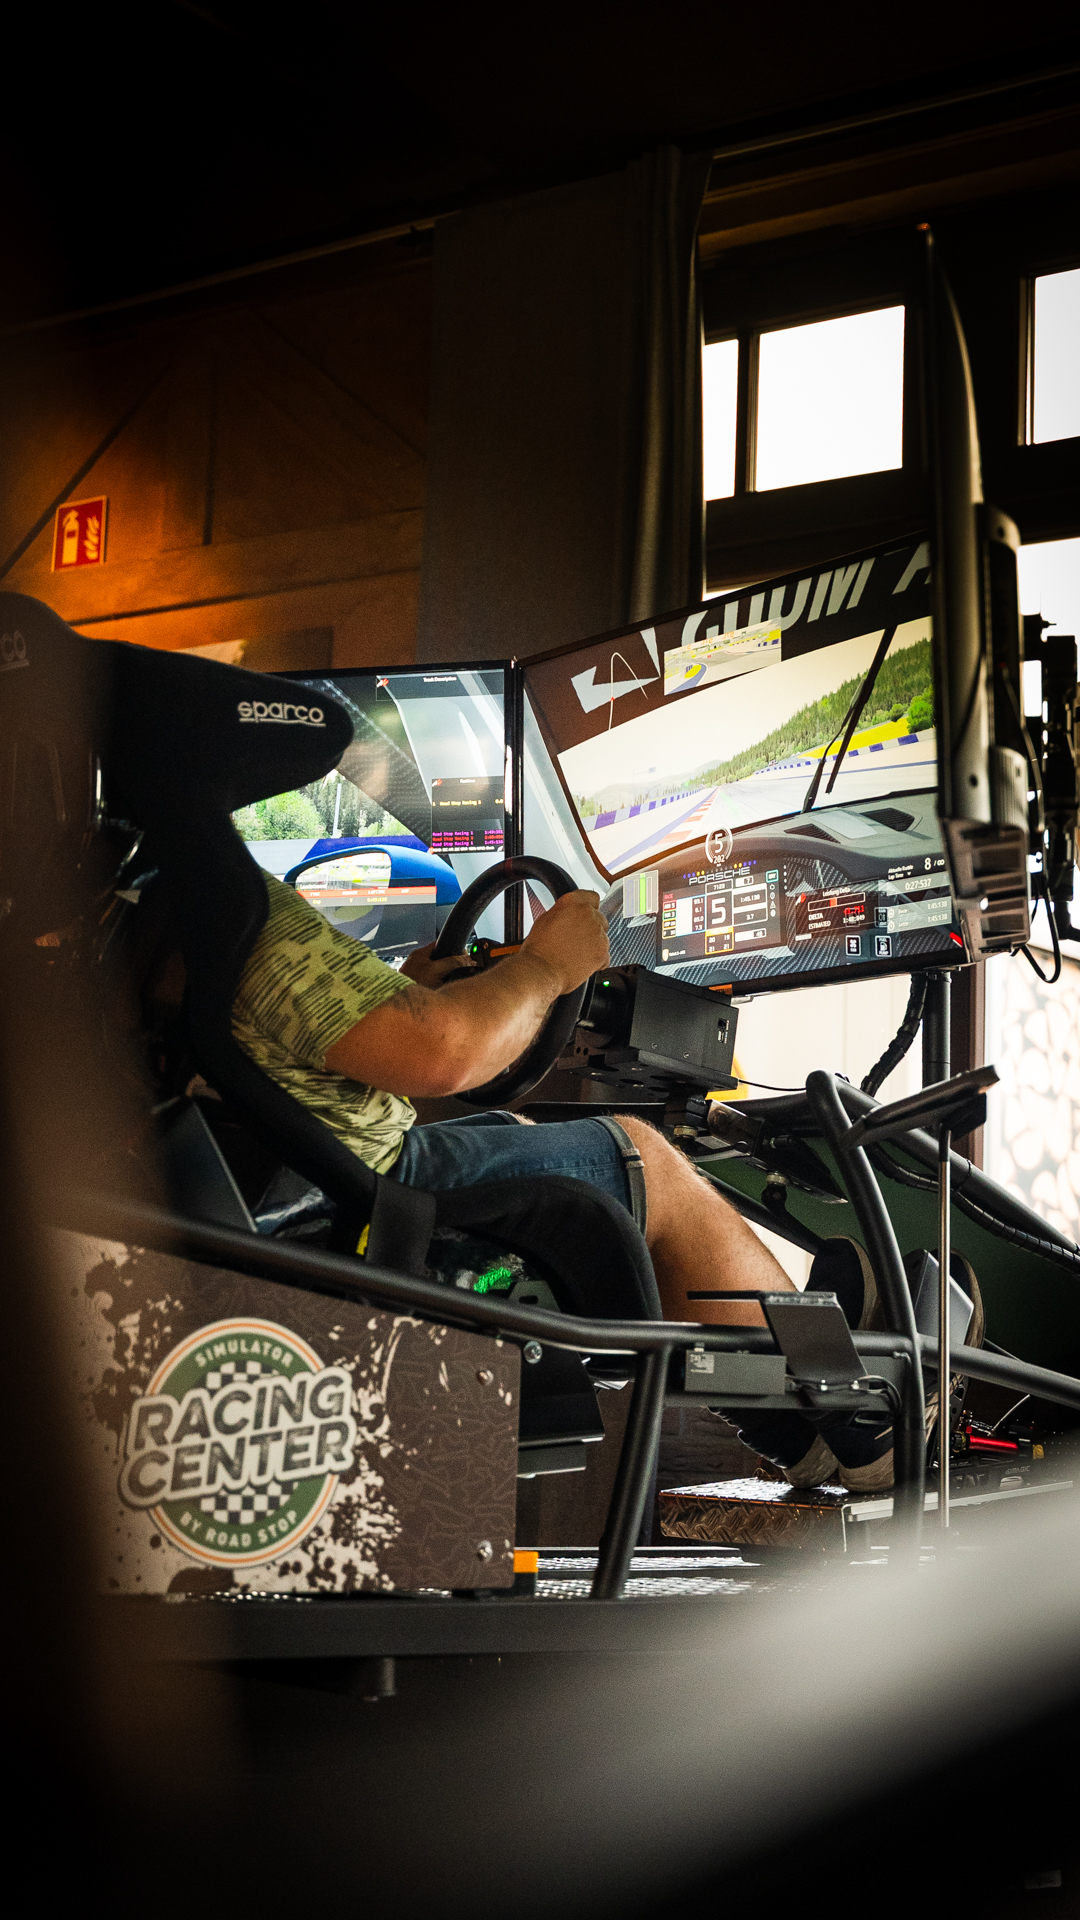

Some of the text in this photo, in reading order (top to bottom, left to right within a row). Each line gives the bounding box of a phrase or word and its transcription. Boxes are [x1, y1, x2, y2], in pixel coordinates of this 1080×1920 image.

[237, 701, 326, 726] sparco
[714, 833, 724, 853] 5
[689, 866, 750, 886] PORSCHE
[924, 857, 932, 870] 8
[711, 897, 727, 925] 5
[808, 920, 831, 930] ESTIMATED
[196, 1340, 296, 1368] SIMULATOR
[134, 1373, 346, 1451] RACING
[126, 1420, 350, 1494] CENTER
[179, 1510, 300, 1549] BY ROAD STOP
